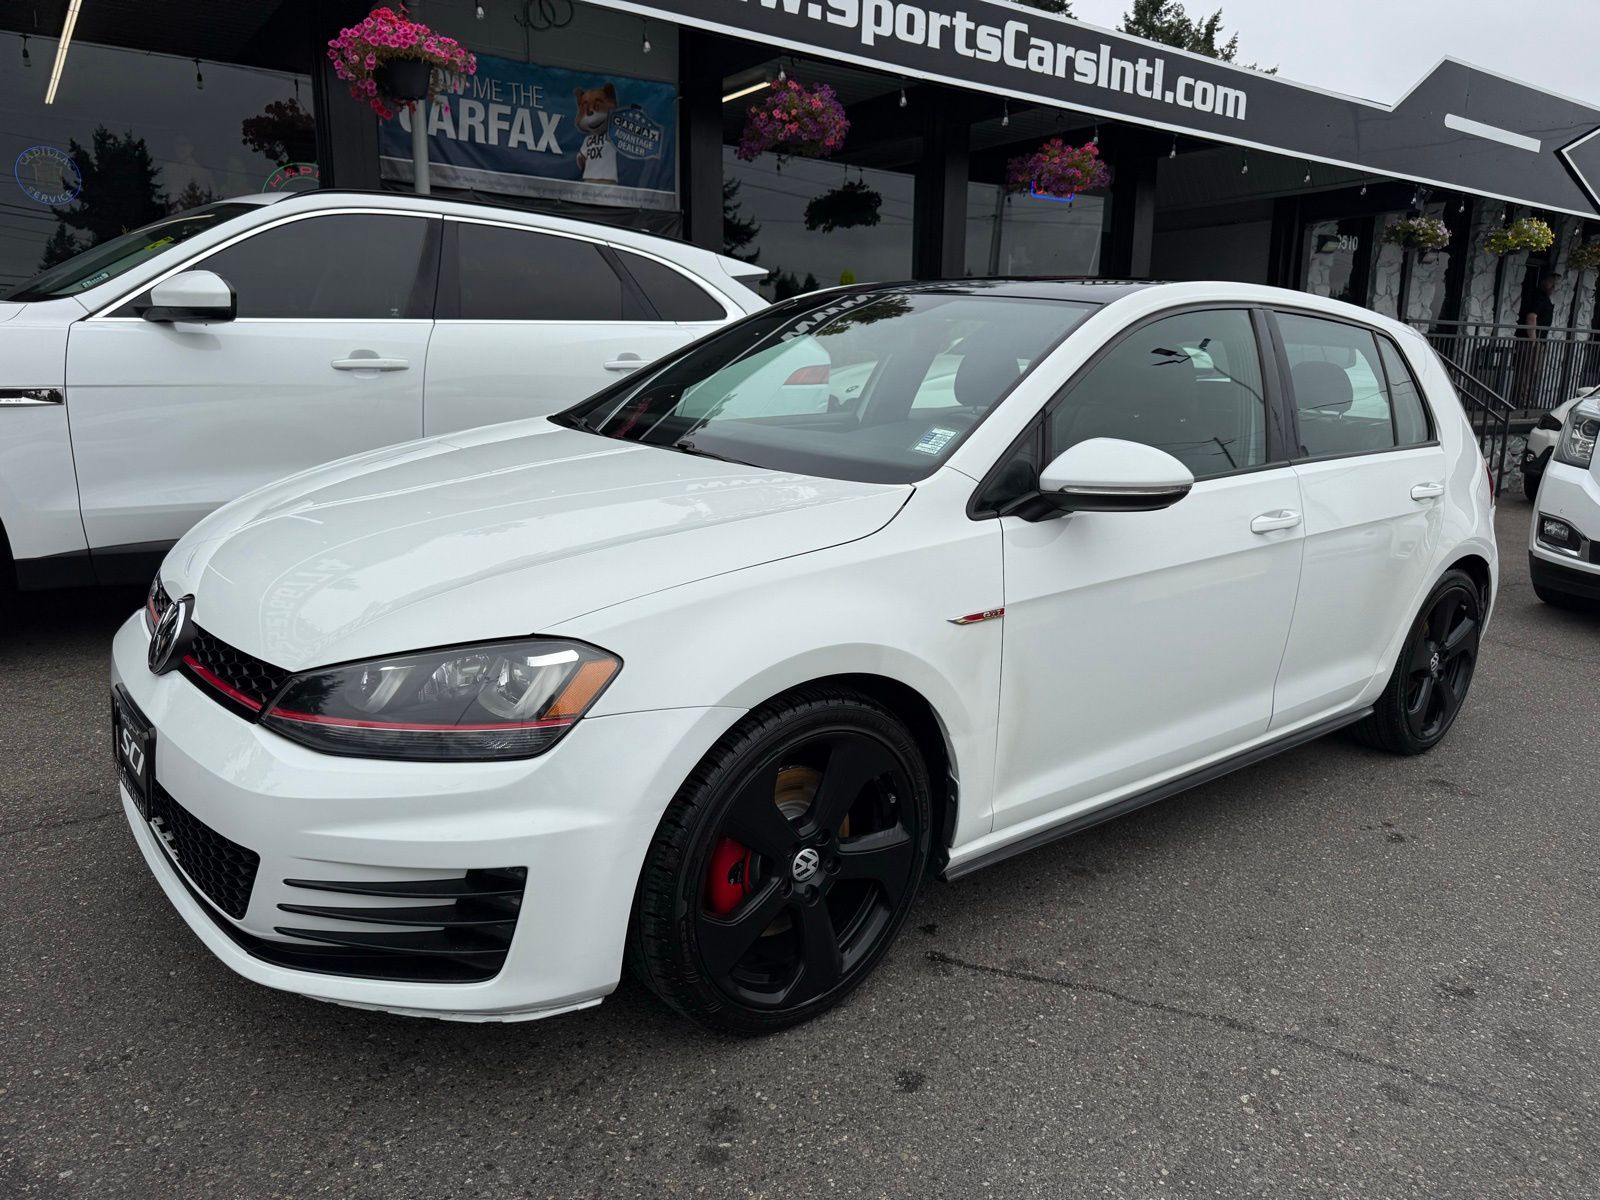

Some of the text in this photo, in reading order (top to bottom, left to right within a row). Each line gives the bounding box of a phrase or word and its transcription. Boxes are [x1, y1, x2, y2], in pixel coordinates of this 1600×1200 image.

[473, 75, 503, 102] ME
[507, 81, 544, 109] THE
[613, 116, 660, 142] CARFAX
[615, 128, 654, 150] ADVANTAGE
[587, 146, 603, 159] FOX
[617, 140, 645, 157] DEALER
[120, 727, 145, 777] SCI
